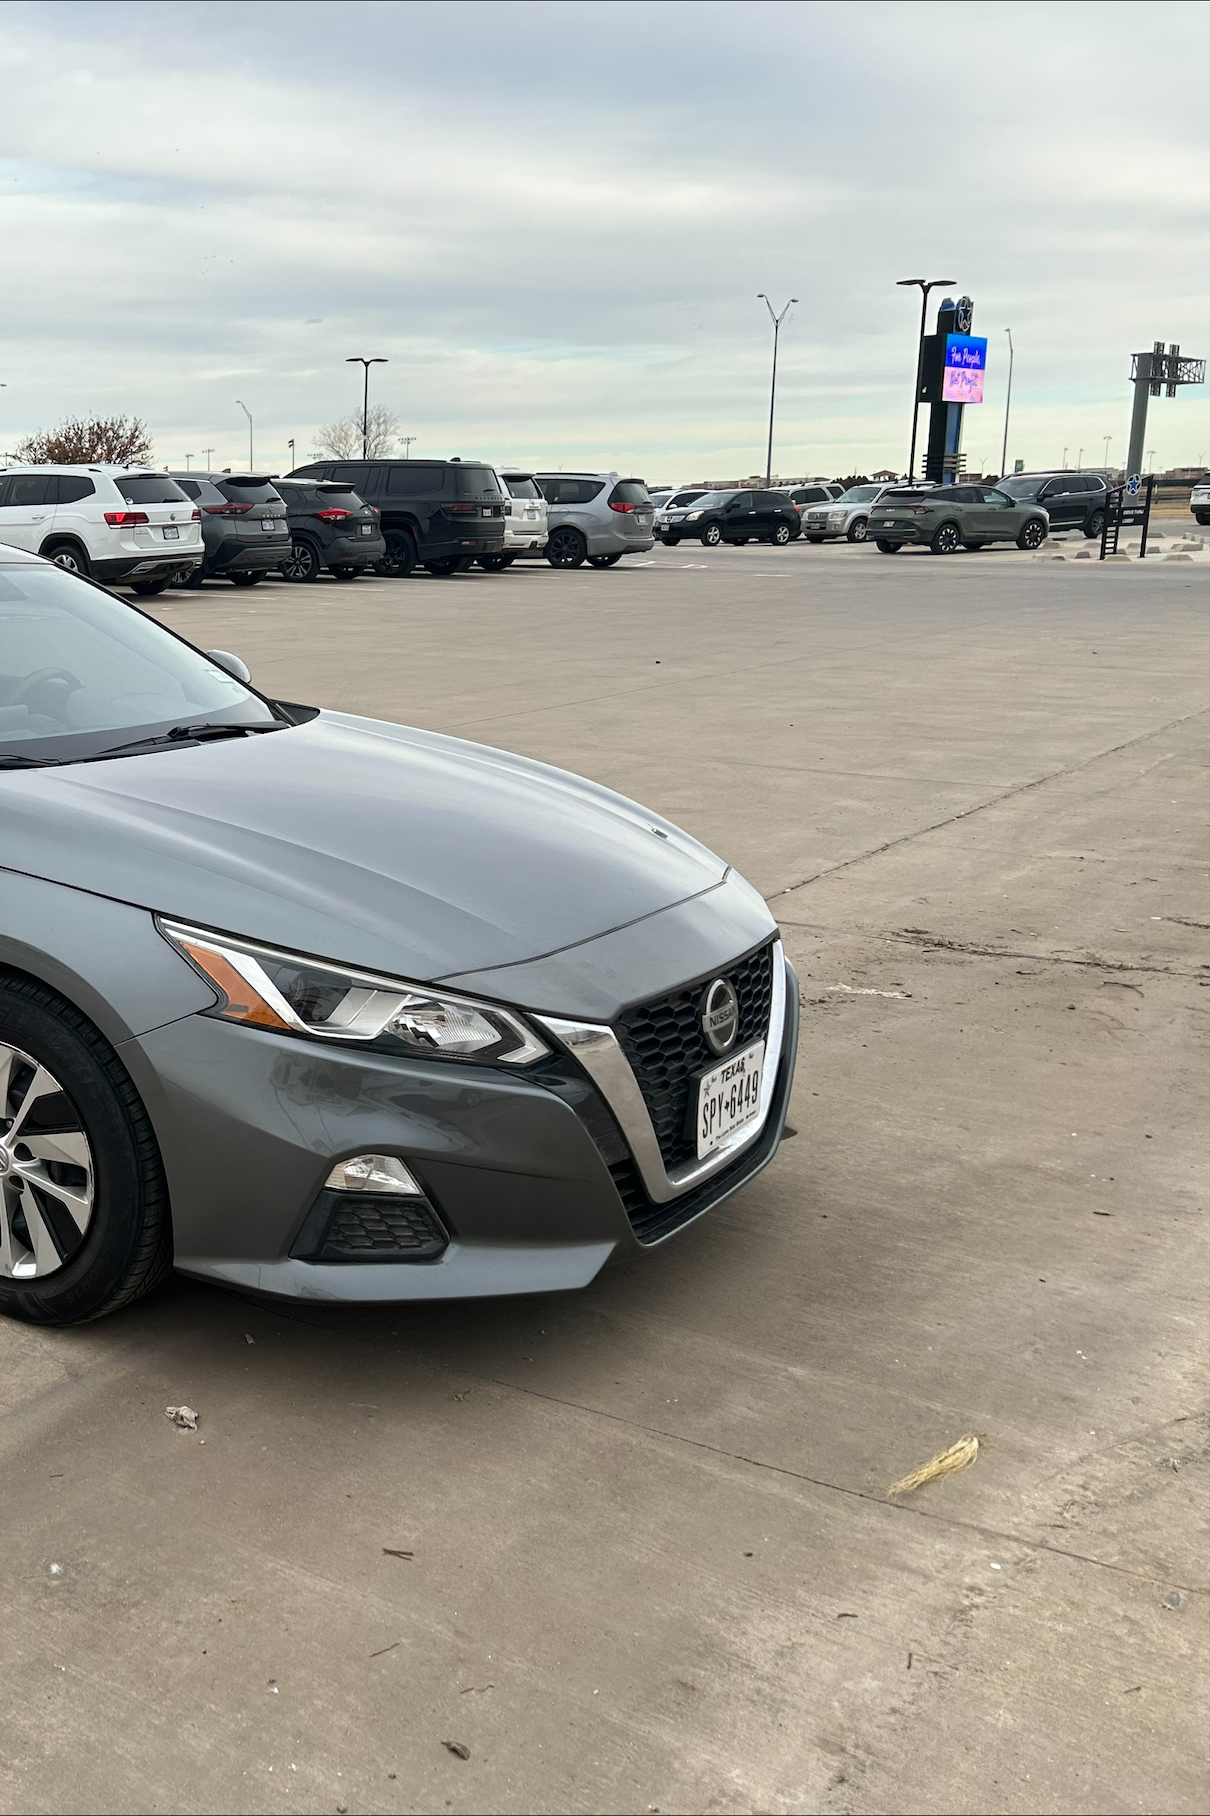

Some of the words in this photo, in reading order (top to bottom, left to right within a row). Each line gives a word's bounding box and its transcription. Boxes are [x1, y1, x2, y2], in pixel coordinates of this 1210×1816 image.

[962, 347, 980, 369] People
[960, 371, 978, 394] Profit
[710, 1005, 737, 1028] NISSAN
[720, 1057, 746, 1084] TEXAS
